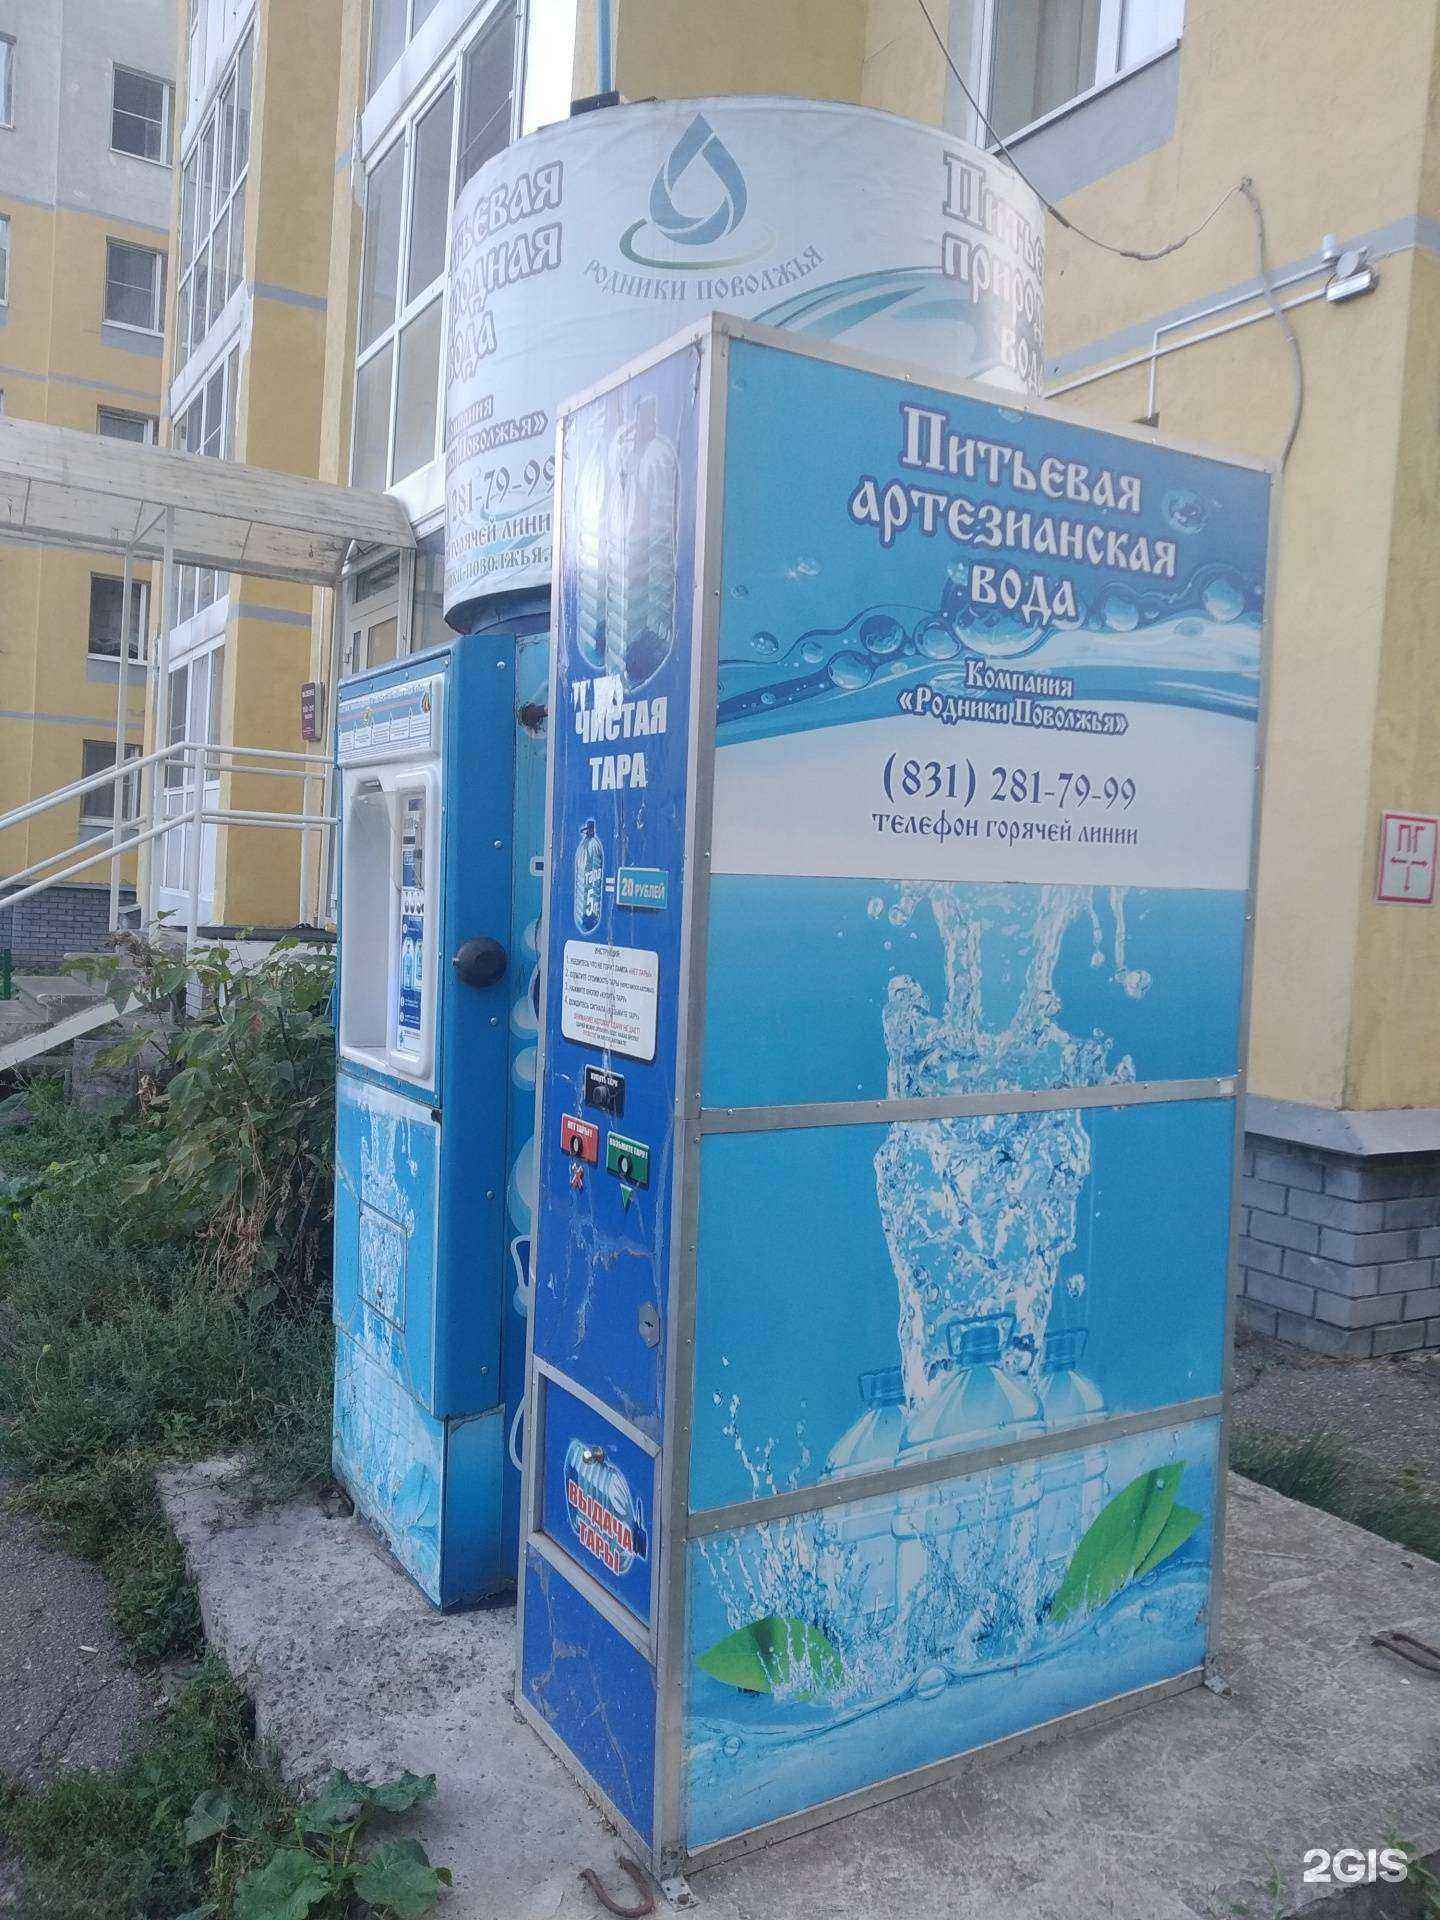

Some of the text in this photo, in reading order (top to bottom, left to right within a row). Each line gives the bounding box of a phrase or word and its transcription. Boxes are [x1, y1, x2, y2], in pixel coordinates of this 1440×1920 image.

[901, 404, 1142, 514] Питьевая
[851, 480, 1177, 578] артезианская
[970, 564, 1077, 625] вода
[966, 658, 1074, 698] Компания
[575, 696, 668, 744] ЧИСТАЯ
[589, 752, 647, 791] ТАРА
[883, 753, 1137, 810] (831) 281-79-99
[871, 809, 1138, 847] телефон горячей линии
[568, 1479, 636, 1555] ВЫДАЧА
[577, 1521, 621, 1577] ТАРЫ
